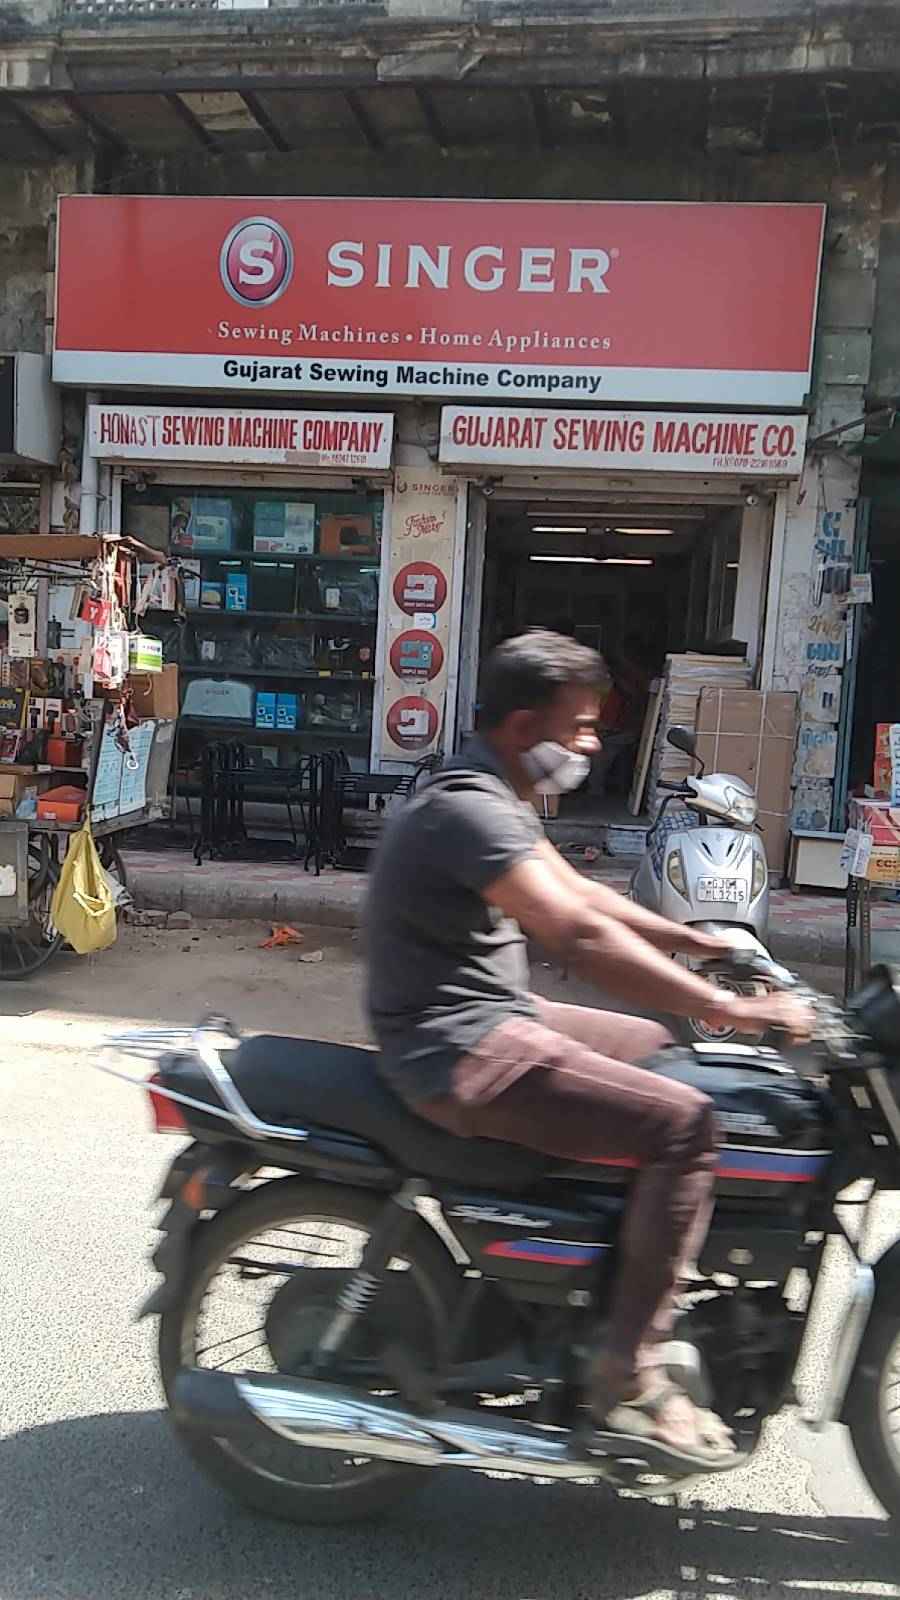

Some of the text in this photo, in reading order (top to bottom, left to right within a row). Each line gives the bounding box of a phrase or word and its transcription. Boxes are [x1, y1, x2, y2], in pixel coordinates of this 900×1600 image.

[327, 241, 610, 294] SINGER
[218, 321, 611, 352] Sewing Machines Home Appliances
[223, 359, 602, 394] Gujarat Sewing Machine Company
[162, 414, 225, 448] SEWING
[227, 416, 298, 450] MACHINE
[302, 418, 384, 453] COMPANY
[452, 415, 797, 457] GUJARAT SEWING MACHINE CO.
